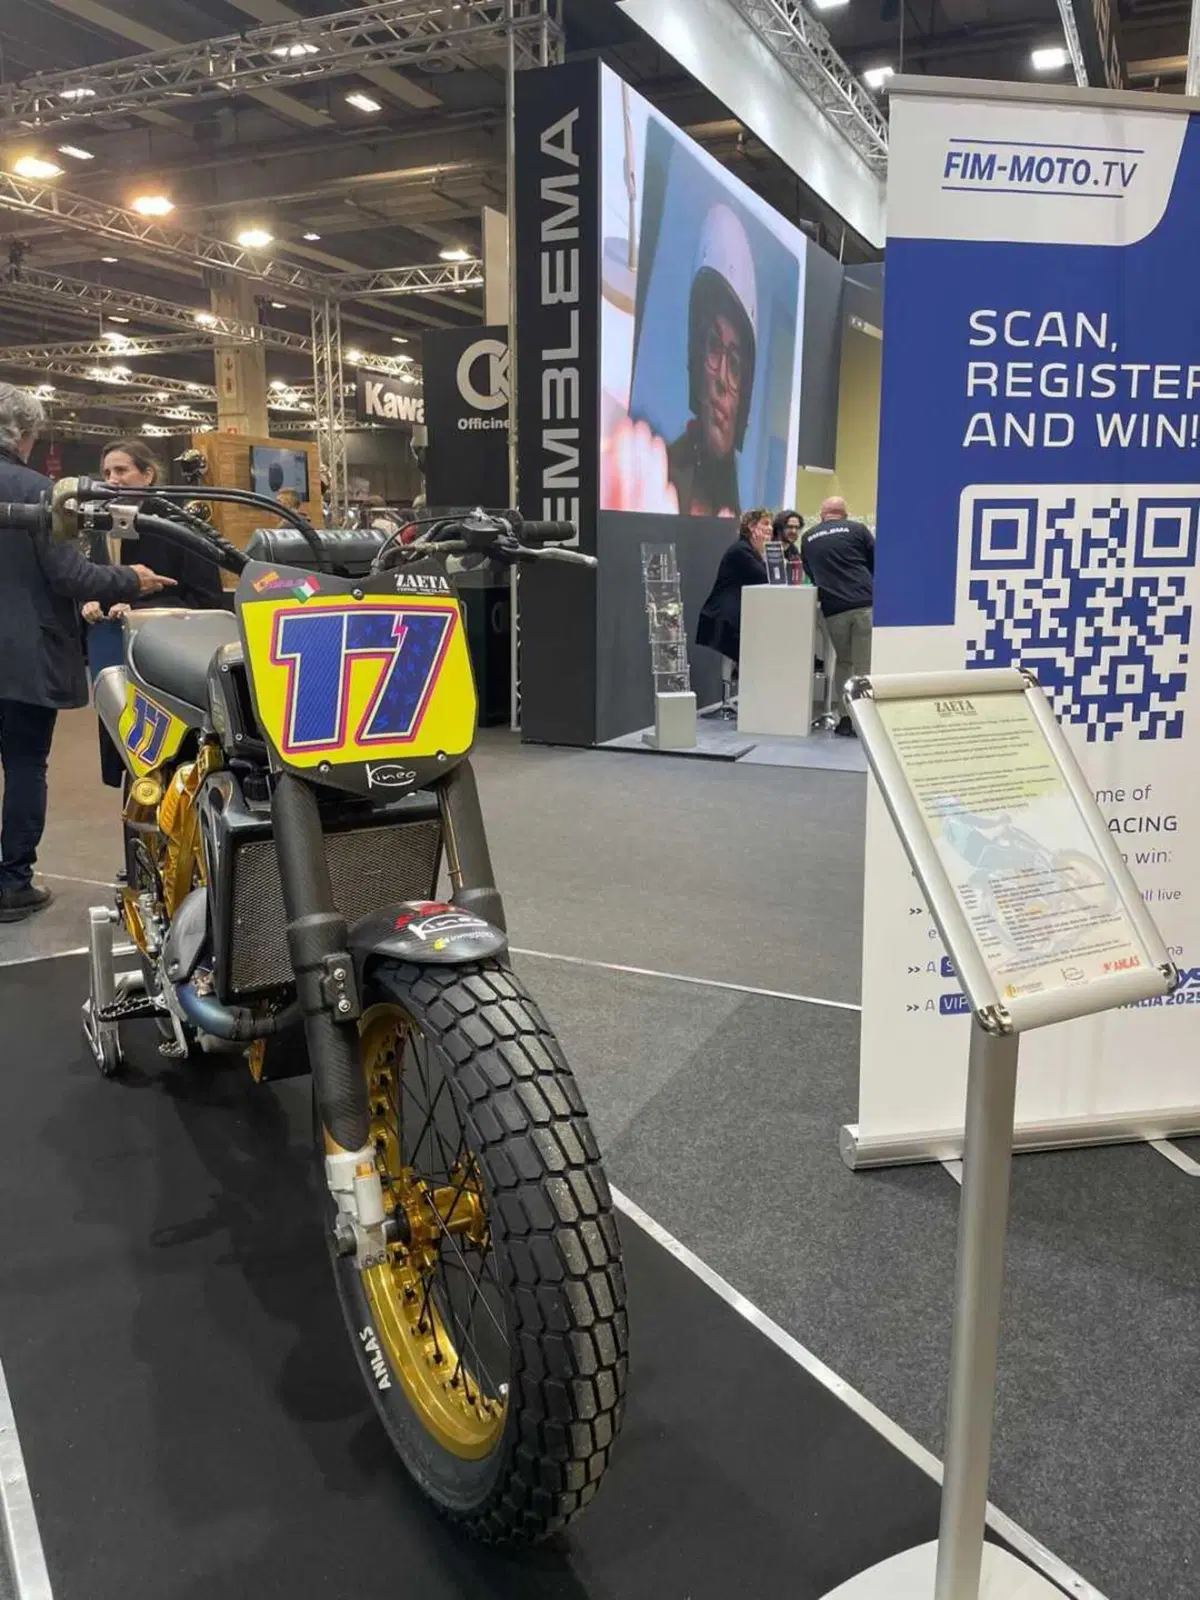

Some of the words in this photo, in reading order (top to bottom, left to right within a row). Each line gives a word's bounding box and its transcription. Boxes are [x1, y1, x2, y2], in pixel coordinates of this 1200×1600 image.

[943, 151, 1138, 188] FIM-MOTO.TV
[540, 107, 580, 547] EMBLEMA
[968, 309, 1118, 353] SCAN,
[963, 412, 1076, 448] AND
[1095, 413, 1199, 449] WIN!
[394, 573, 450, 590] ZAETA
[271, 604, 457, 753] 17
[126, 687, 172, 766] 17
[1132, 784, 1152, 801] of
[1107, 815, 1178, 833] ACING
[1157, 888, 1182, 901] live
[359, 1326, 391, 1390] ANLAS
